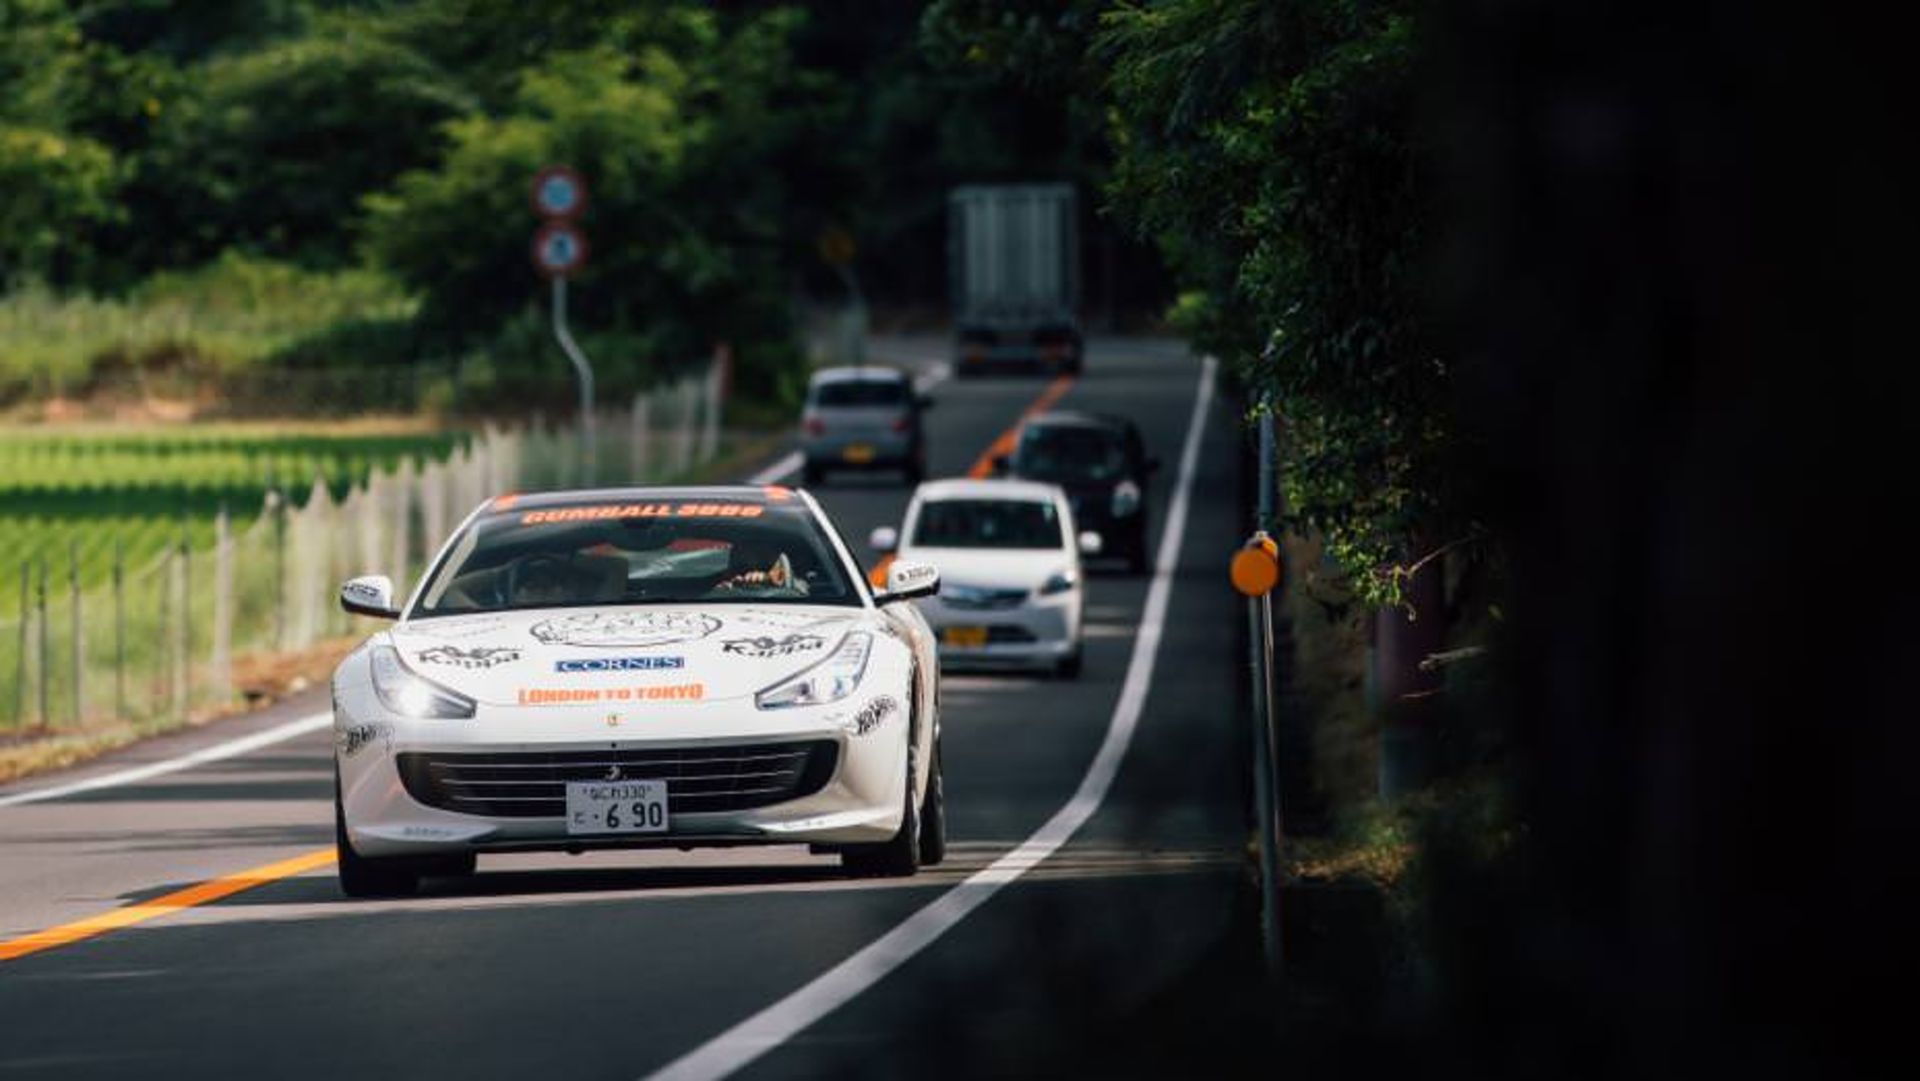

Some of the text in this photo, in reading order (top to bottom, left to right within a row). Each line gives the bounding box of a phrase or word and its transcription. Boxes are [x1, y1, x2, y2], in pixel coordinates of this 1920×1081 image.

[522, 503, 672, 526] GUMBALL
[722, 639, 824, 658] Kappa
[560, 657, 682, 671] CORNES
[518, 683, 705, 706] LONDON TO TOKYO
